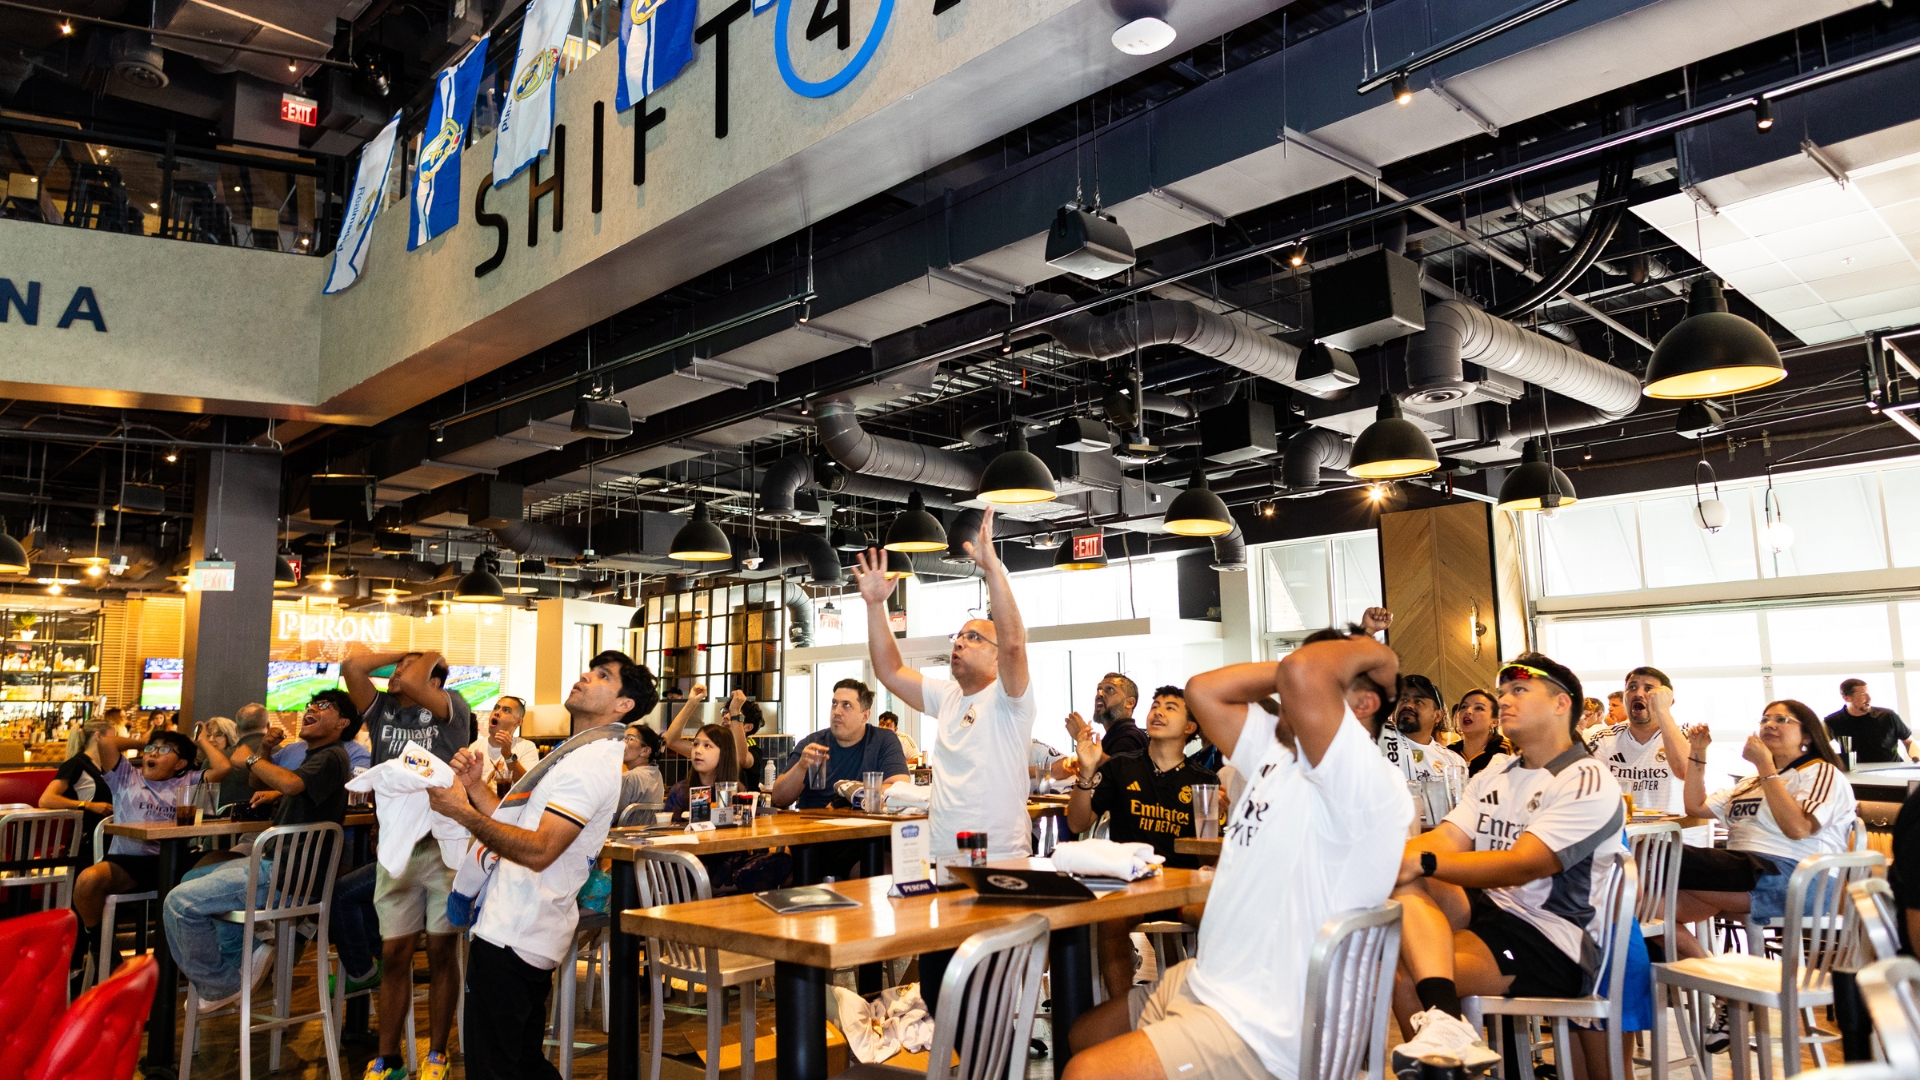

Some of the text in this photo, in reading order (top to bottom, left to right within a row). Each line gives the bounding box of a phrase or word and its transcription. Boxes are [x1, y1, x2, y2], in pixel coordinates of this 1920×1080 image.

[288, 103, 312, 123] EXIT
[1079, 537, 1099, 557] EXIT
[278, 611, 392, 643] PERONI
[381, 724, 440, 741] Emirates
[1384, 736, 1400, 767] eal
[1610, 765, 1668, 780] Emirates
[1130, 799, 1189, 825] Emirates
[1728, 798, 1763, 818] Teka
[1139, 817, 1154, 831] FLY
[902, 882, 930, 893] PERONI
